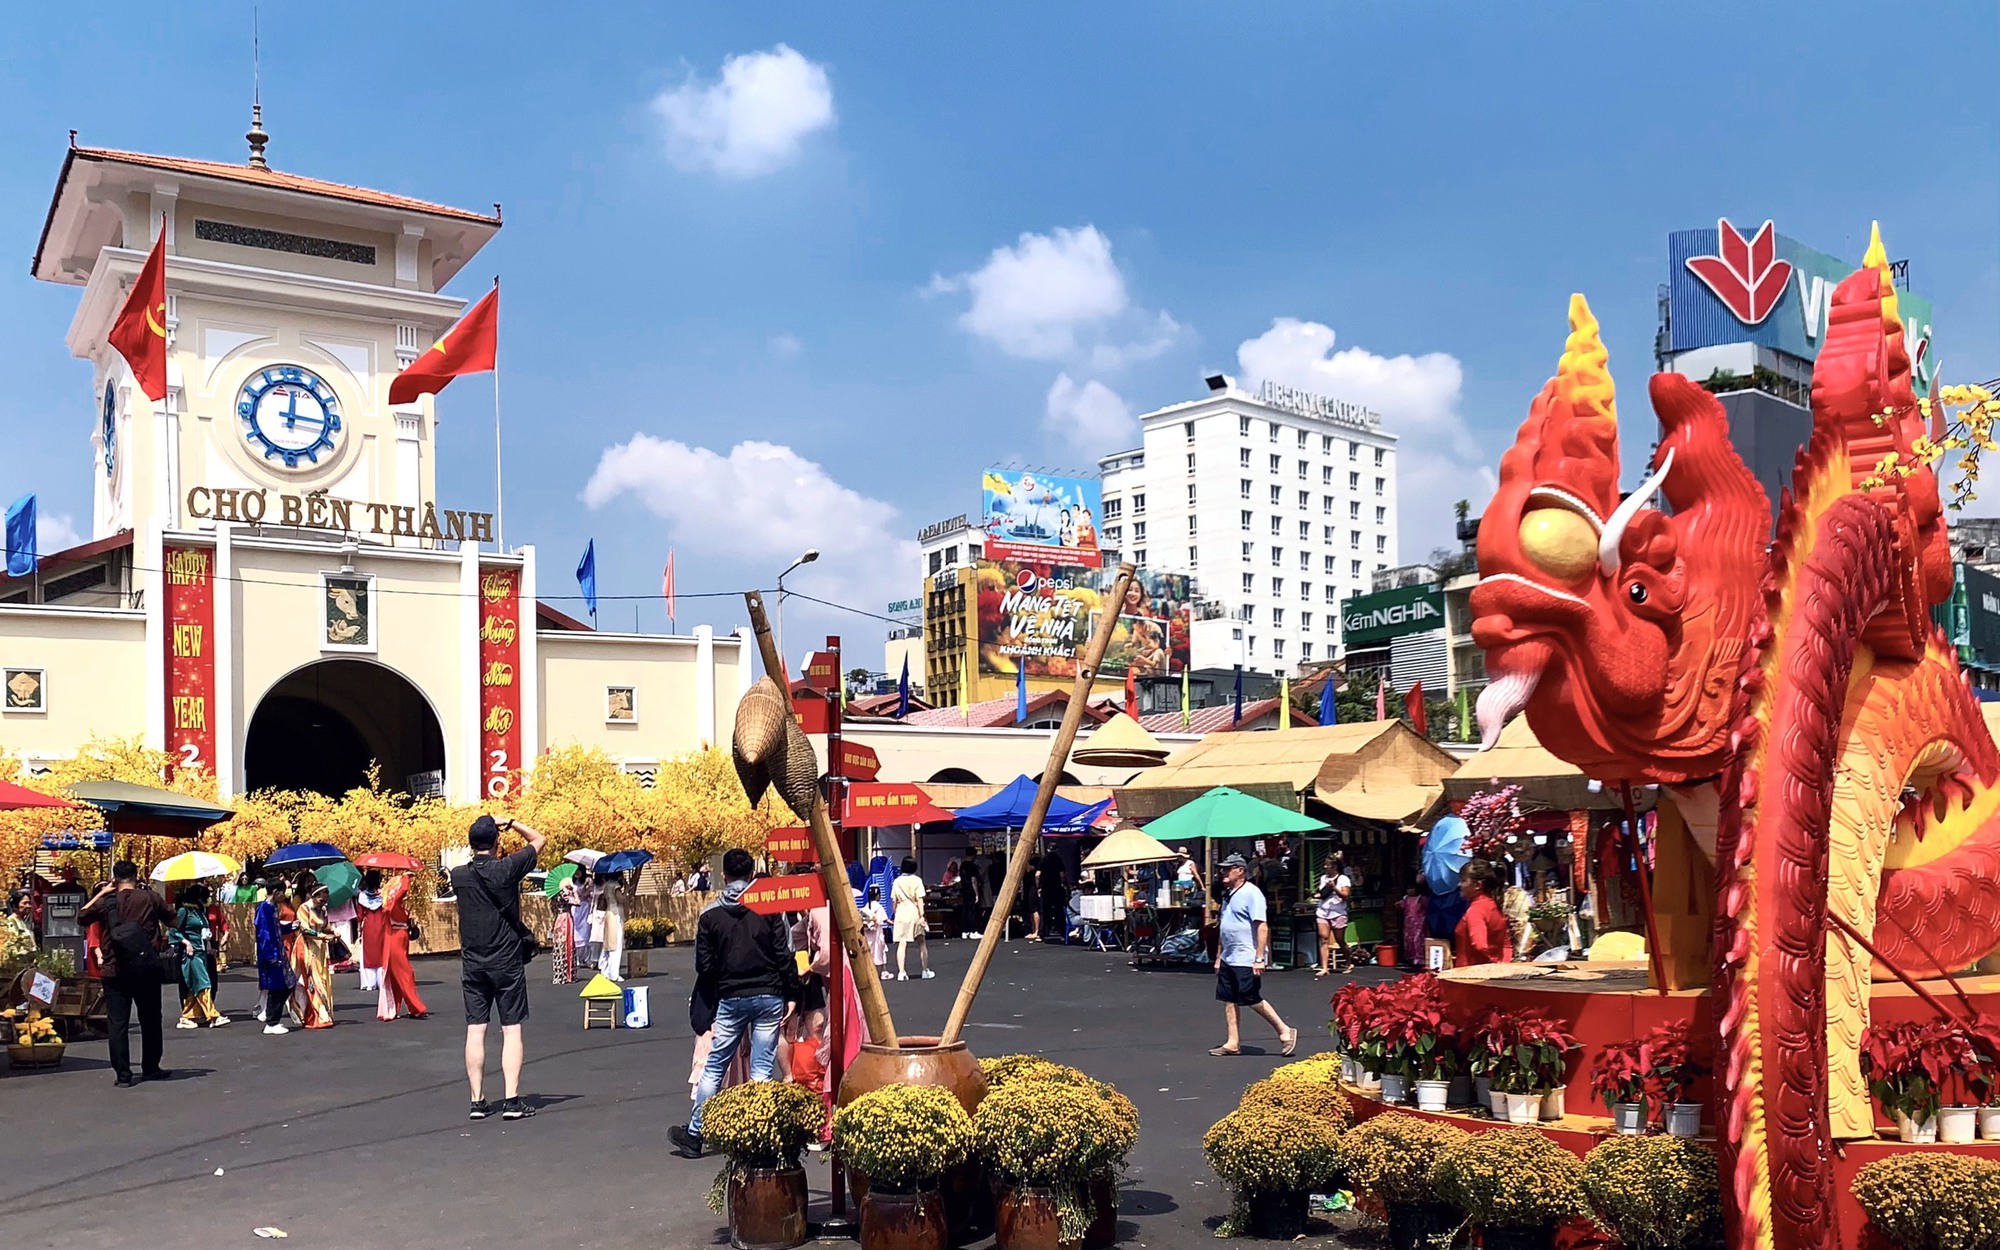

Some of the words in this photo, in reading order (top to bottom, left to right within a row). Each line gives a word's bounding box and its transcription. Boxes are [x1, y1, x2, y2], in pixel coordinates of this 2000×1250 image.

[187, 487, 267, 528] CHỢ
[280, 488, 353, 530] BẾN
[366, 501, 494, 542] THÀNH
[165, 551, 208, 586] HAPPY
[1037, 577, 1074, 590] pepsi
[999, 590, 1053, 614] MANG
[1053, 594, 1085, 618] TẾT
[173, 624, 203, 658] NEW
[480, 614, 517, 648] Mừng
[1040, 617, 1078, 641] NHÀ
[482, 660, 514, 687] Năm
[172, 696, 207, 732] YEAR
[483, 705, 514, 735] Mới
[855, 796, 870, 807] KHU
[900, 794, 919, 807] THỰC
[743, 892, 759, 904] KHU
[760, 890, 776, 903] VỰC
[791, 887, 811, 900] THỰC
